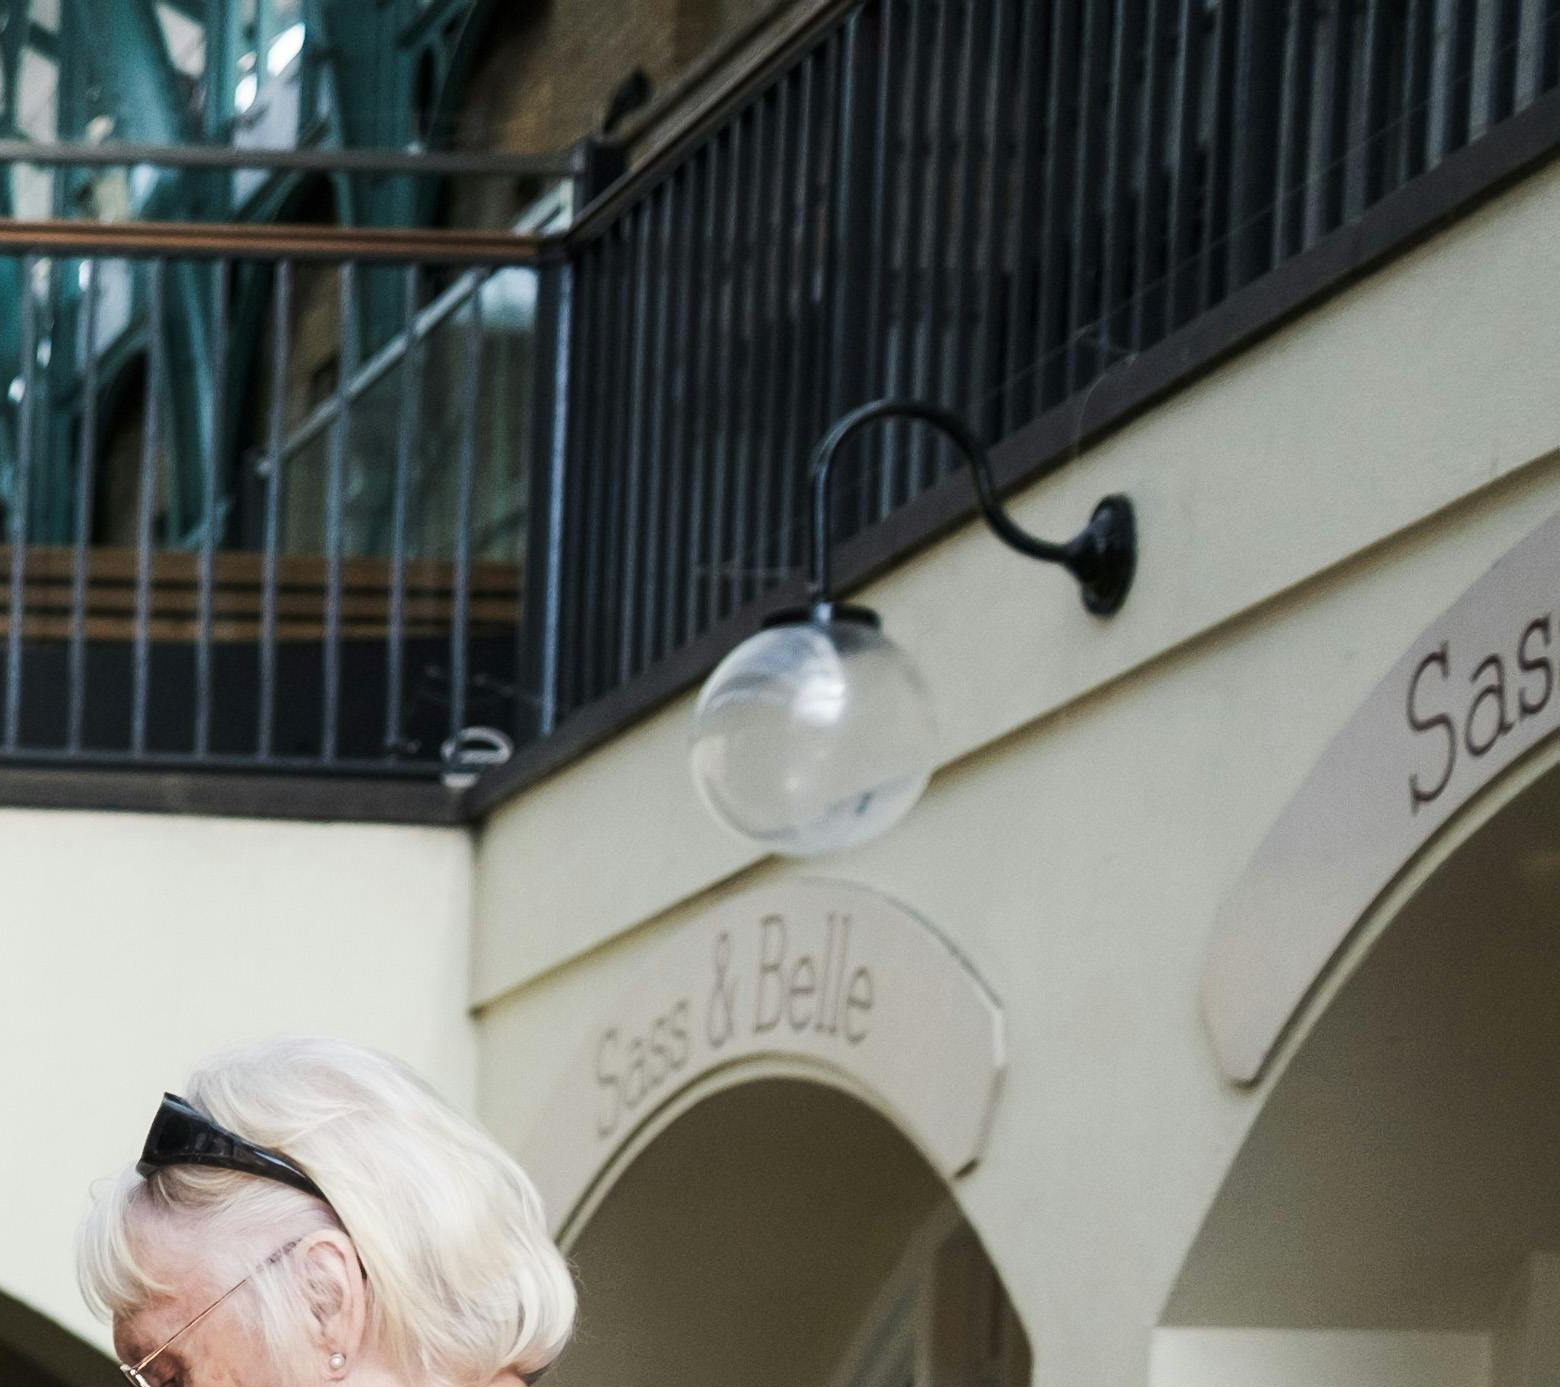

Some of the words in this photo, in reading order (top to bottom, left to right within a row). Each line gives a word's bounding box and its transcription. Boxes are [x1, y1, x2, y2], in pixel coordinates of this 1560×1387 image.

[596, 1000, 690, 1140] Sass
[705, 931, 734, 1050] &
[752, 912, 875, 1047] Belle
